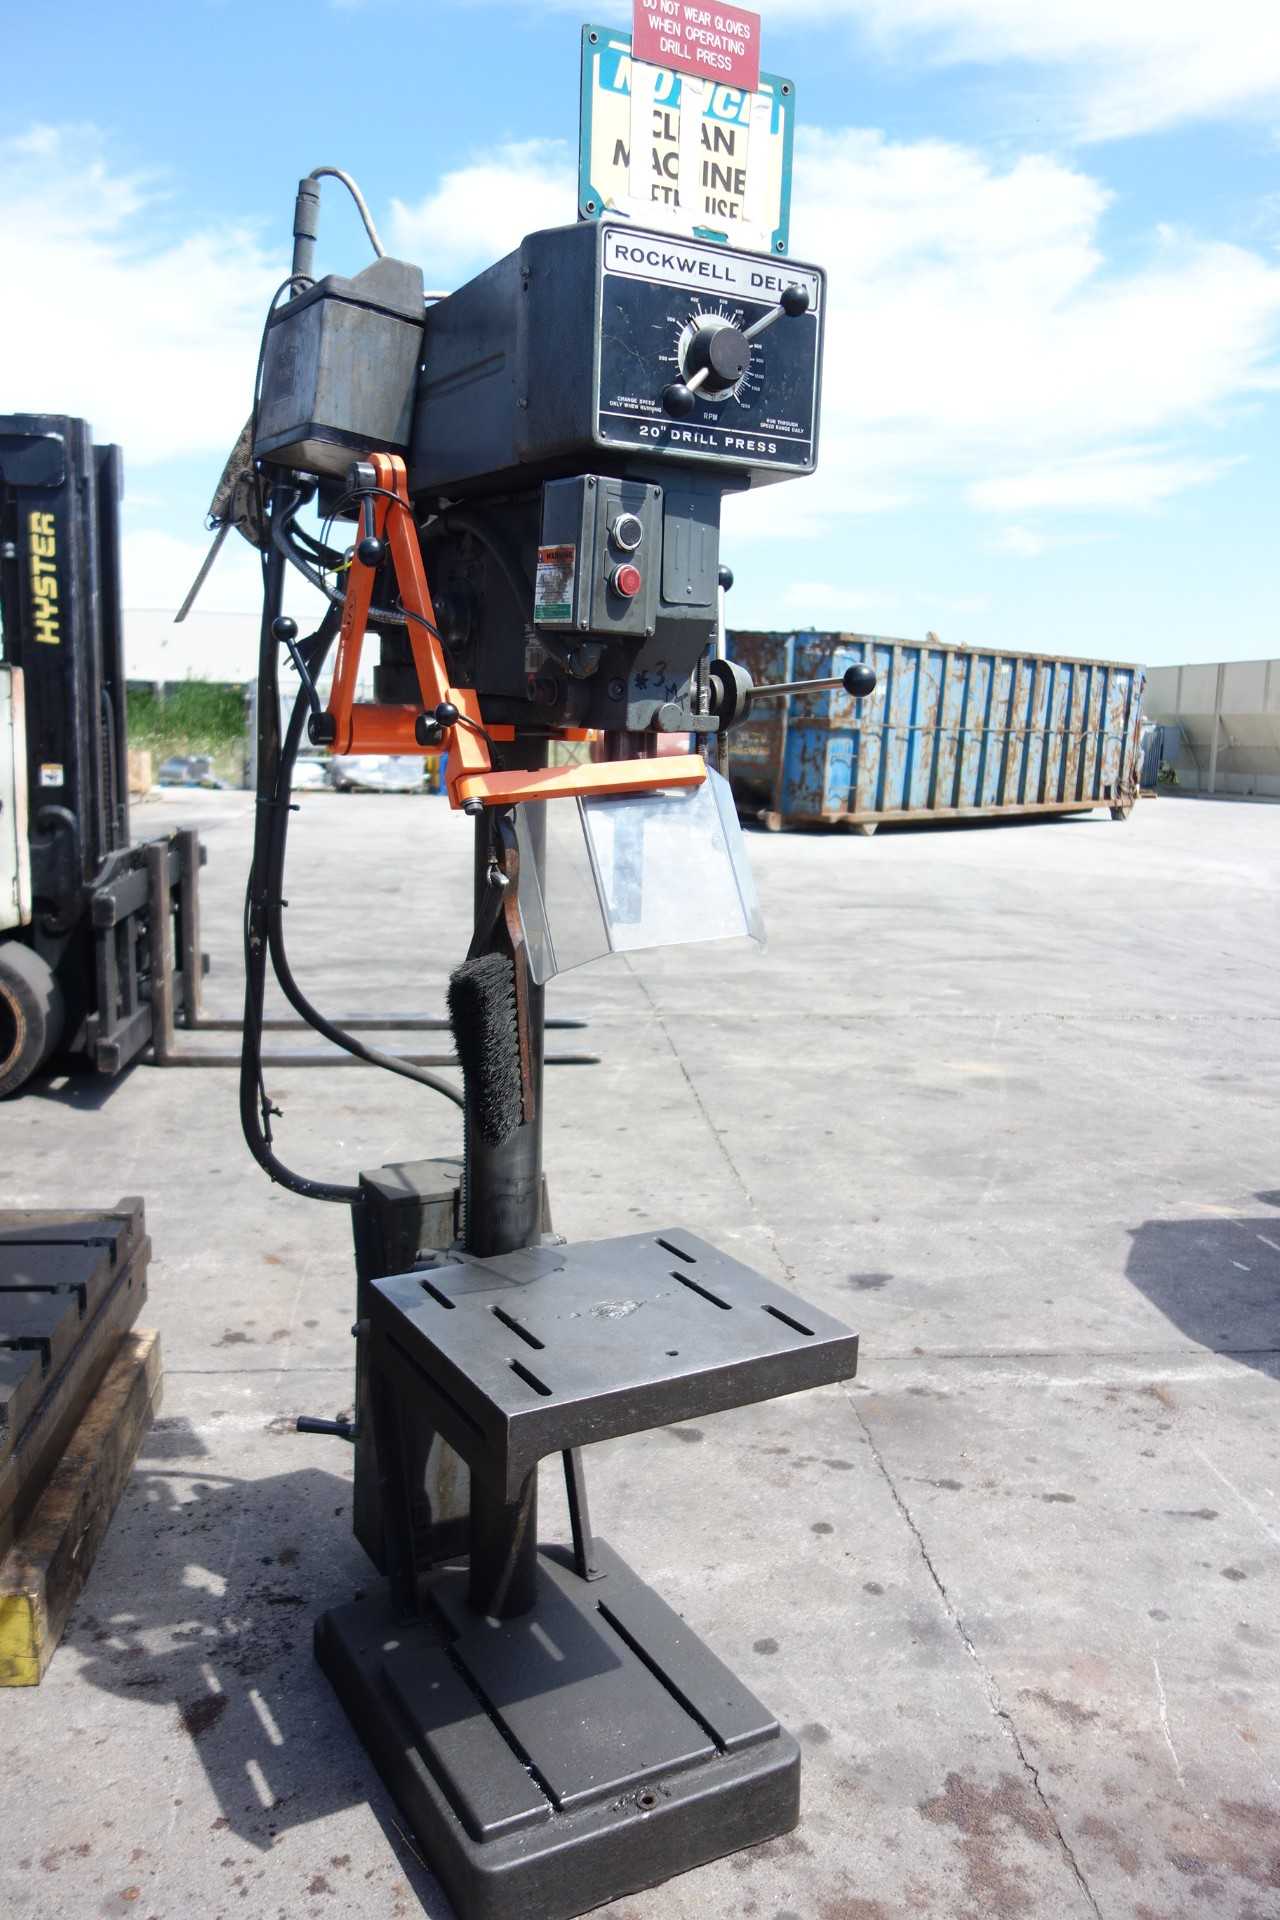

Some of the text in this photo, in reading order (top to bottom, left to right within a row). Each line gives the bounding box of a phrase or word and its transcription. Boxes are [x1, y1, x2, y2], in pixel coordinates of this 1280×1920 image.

[648, 14, 745, 56] WHEN OPERATING
[660, 0, 680, 16] NOT
[684, 6, 711, 26] WEAR
[714, 15, 751, 39] GLOVES
[660, 37, 732, 72] DRILL PRESS
[615, 244, 808, 292] ROCKWELL DEL
[703, 412, 718, 421] RPM
[639, 425, 777, 454] 20" DRILL PRESS
[31, 511, 60, 644] HYSTER
